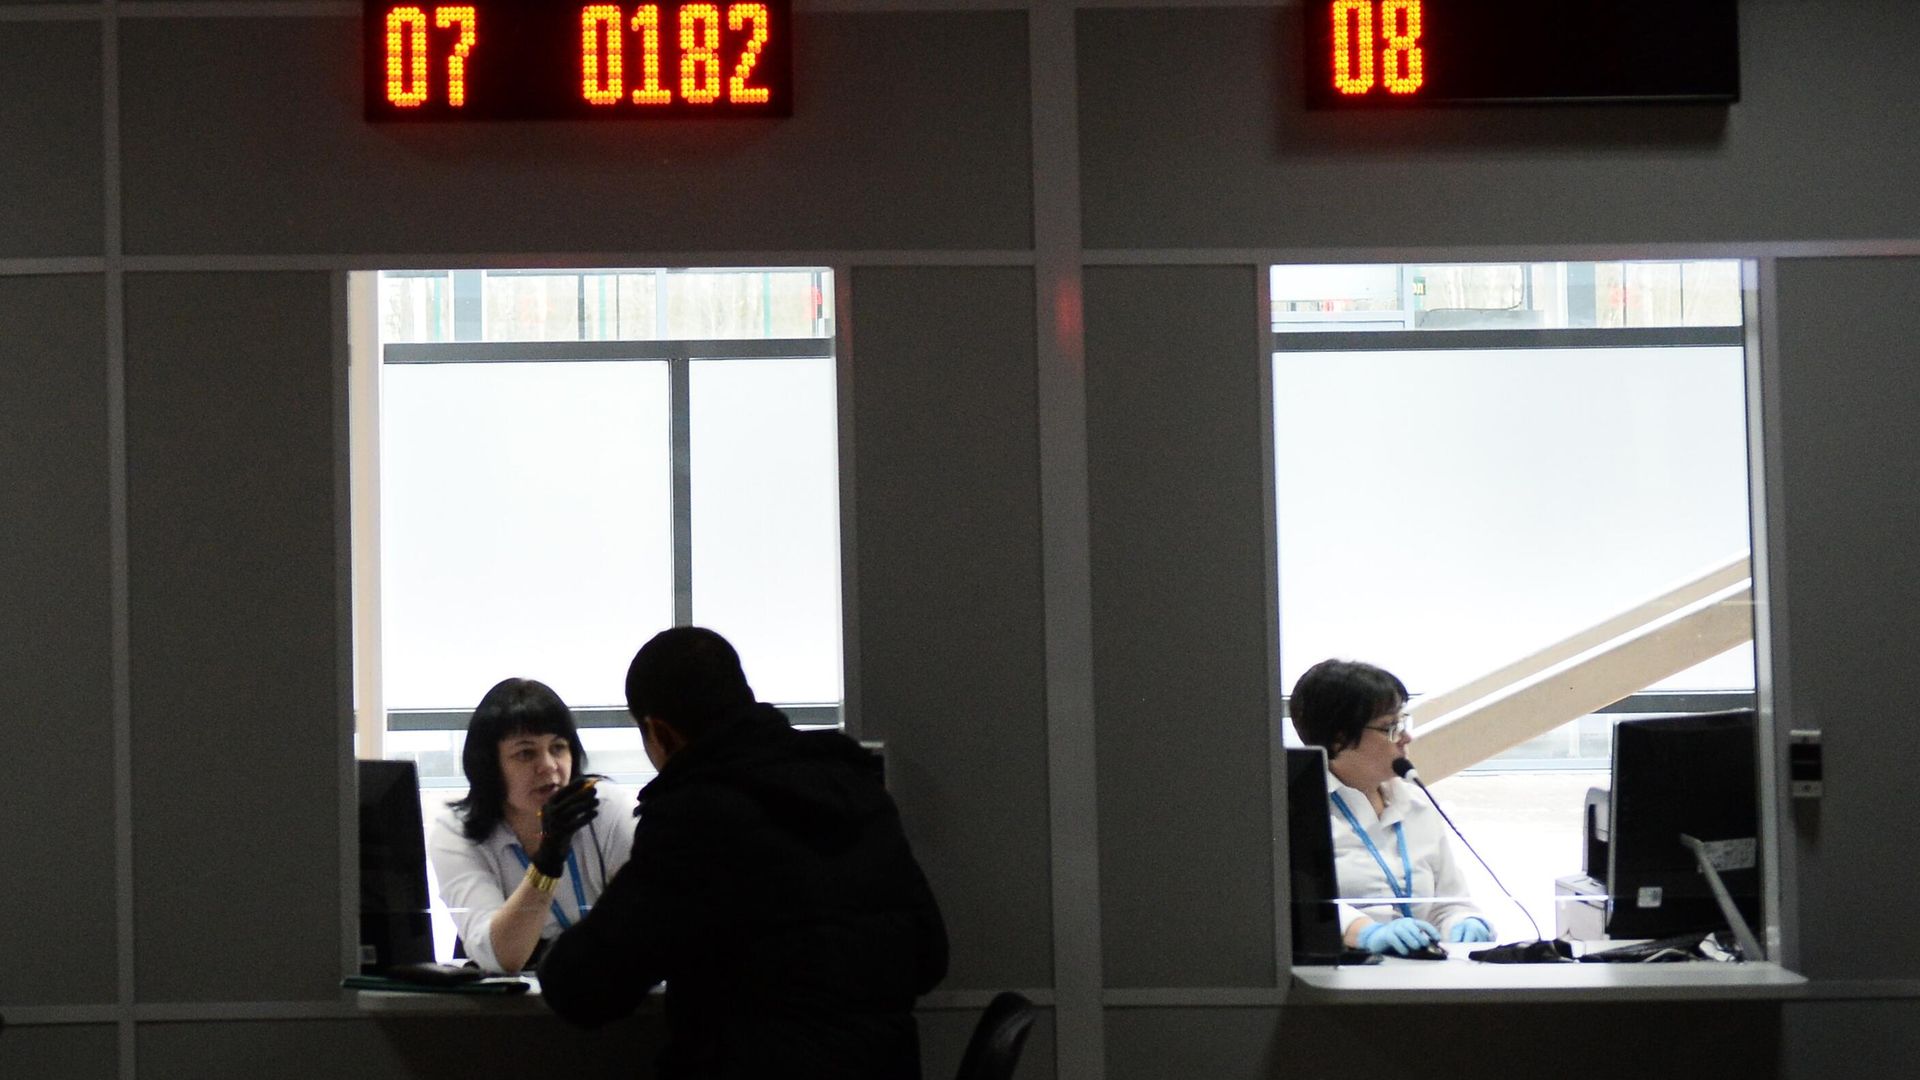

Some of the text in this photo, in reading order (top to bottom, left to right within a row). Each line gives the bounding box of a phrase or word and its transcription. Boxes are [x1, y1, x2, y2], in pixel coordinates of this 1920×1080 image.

[386, 3, 770, 107] 07 0182
[1332, 0, 1424, 95] 08
